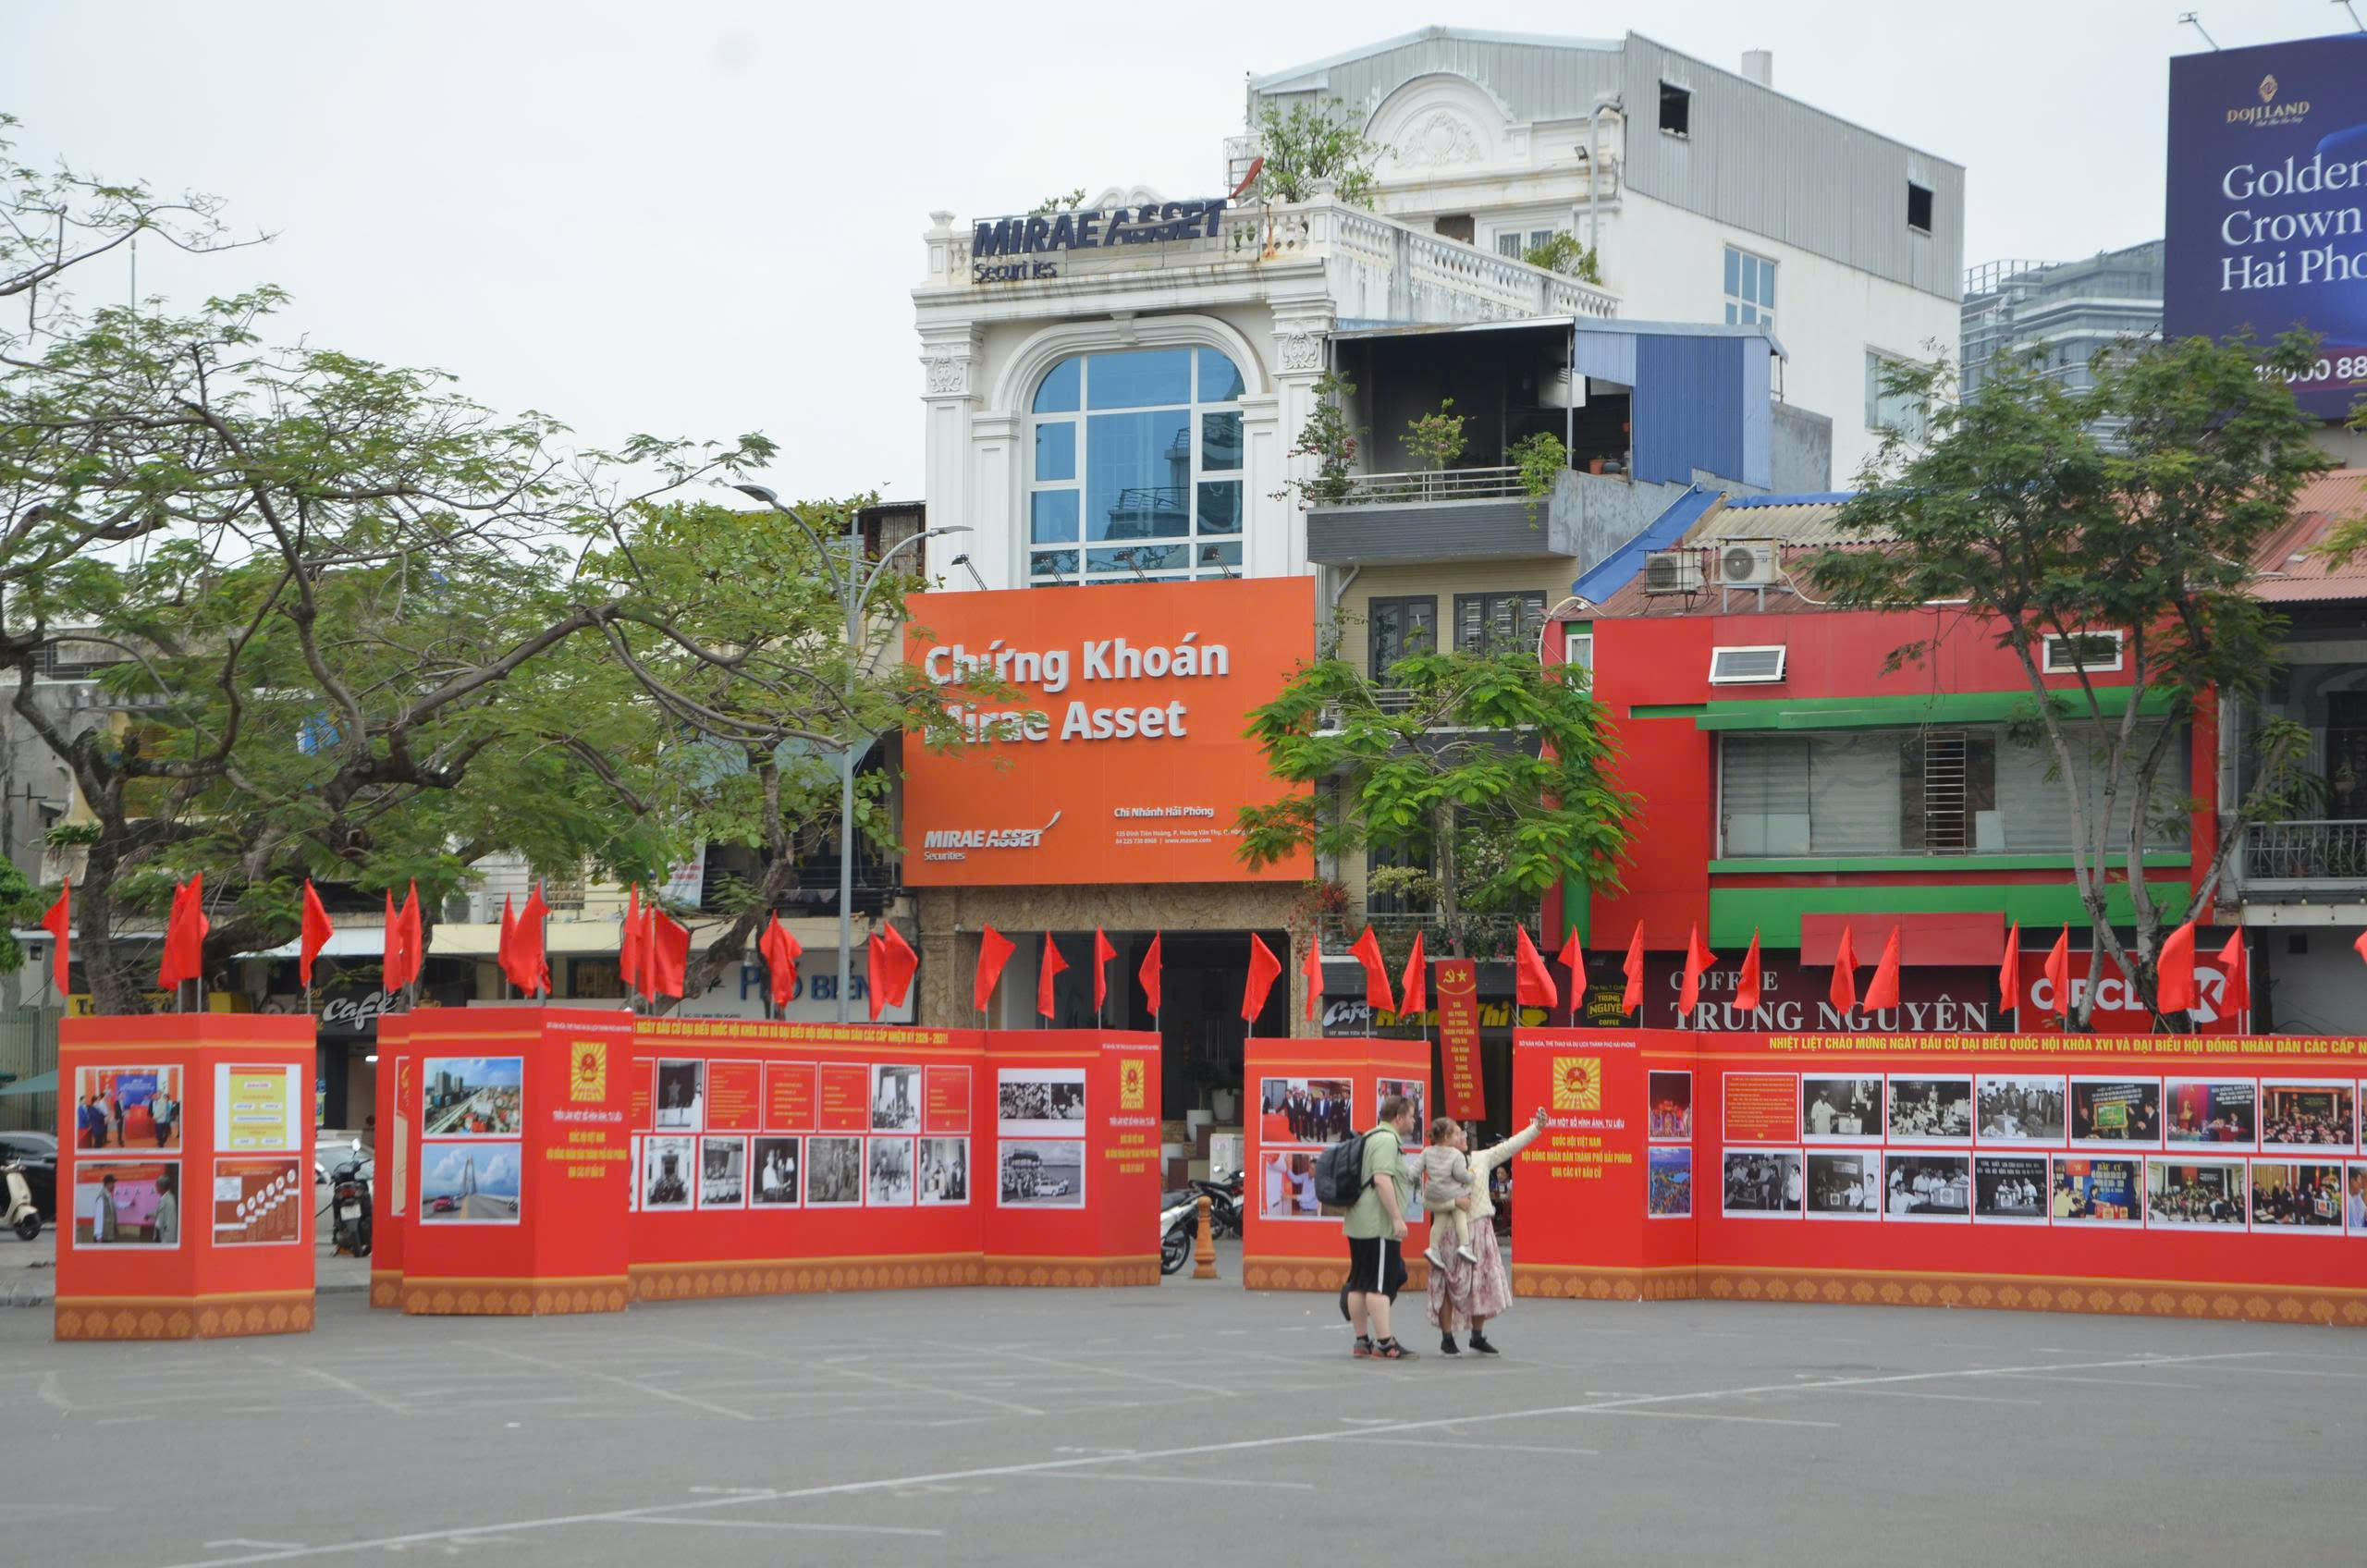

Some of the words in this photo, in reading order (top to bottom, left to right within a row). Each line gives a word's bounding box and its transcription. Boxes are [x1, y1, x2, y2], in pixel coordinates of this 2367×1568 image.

[2223, 153, 2367, 201] Golden
[973, 212, 1100, 258] MIRAE
[1102, 198, 1228, 247] ASSET
[2221, 205, 2363, 246] Crown
[974, 260, 1058, 283] Securiies
[2220, 251, 2288, 292] Hai
[2299, 242, 2367, 286] Pho
[925, 639, 1070, 693] Chứng
[1083, 631, 1230, 680] Khoán
[1061, 700, 1188, 741] Asset
[1114, 806, 1130, 817] Chi
[1131, 806, 1163, 817] Nhánh
[1166, 805, 1182, 816] Hải
[1184, 805, 1215, 818] Phòng
[924, 851, 966, 861] Securities
[925, 829, 986, 849] MIRAE
[985, 828, 1045, 848] ASSET
[1670, 970, 1778, 991] COFFE
[2030, 978, 2149, 1011] CRCL
[1670, 1000, 1804, 1032] TRUNG
[1817, 994, 1989, 1032] NGUYÊN
[1770, 1035, 1798, 1052] NHIỆT
[1802, 1035, 1822, 1052] LIỆT
[1825, 1035, 1852, 1050] CHÀO
[1856, 1035, 1887, 1050] MỪNG
[1889, 1035, 1918, 1050] NGÀY
[1920, 1033, 1942, 1050] BẦU
[1944, 1034, 1959, 1050] CỬ
[1962, 1037, 1980, 1052] ĐẠI
[1982, 1033, 2007, 1050] BIỂU
[2010, 1035, 2039, 1051] QUỐC
[2042, 1035, 2061, 1053] HỘI
[2063, 1035, 2091, 1051] KHÓA
[2094, 1038, 2114, 1052] XVI
[2116, 1035, 2131, 1051] VÀ
[2133, 1038, 2152, 1054] ĐẠI
[2155, 1035, 2181, 1052] BIỂU
[2184, 1037, 2203, 1055] HỘI
[2205, 1035, 2238, 1053] ĐỒNG
[2240, 1037, 2274, 1053] NHÂN
[2276, 1037, 2301, 1054] DÂN
[2304, 1036, 2329, 1054] CÁC
[2331, 1035, 2356, 1054] CẤP
